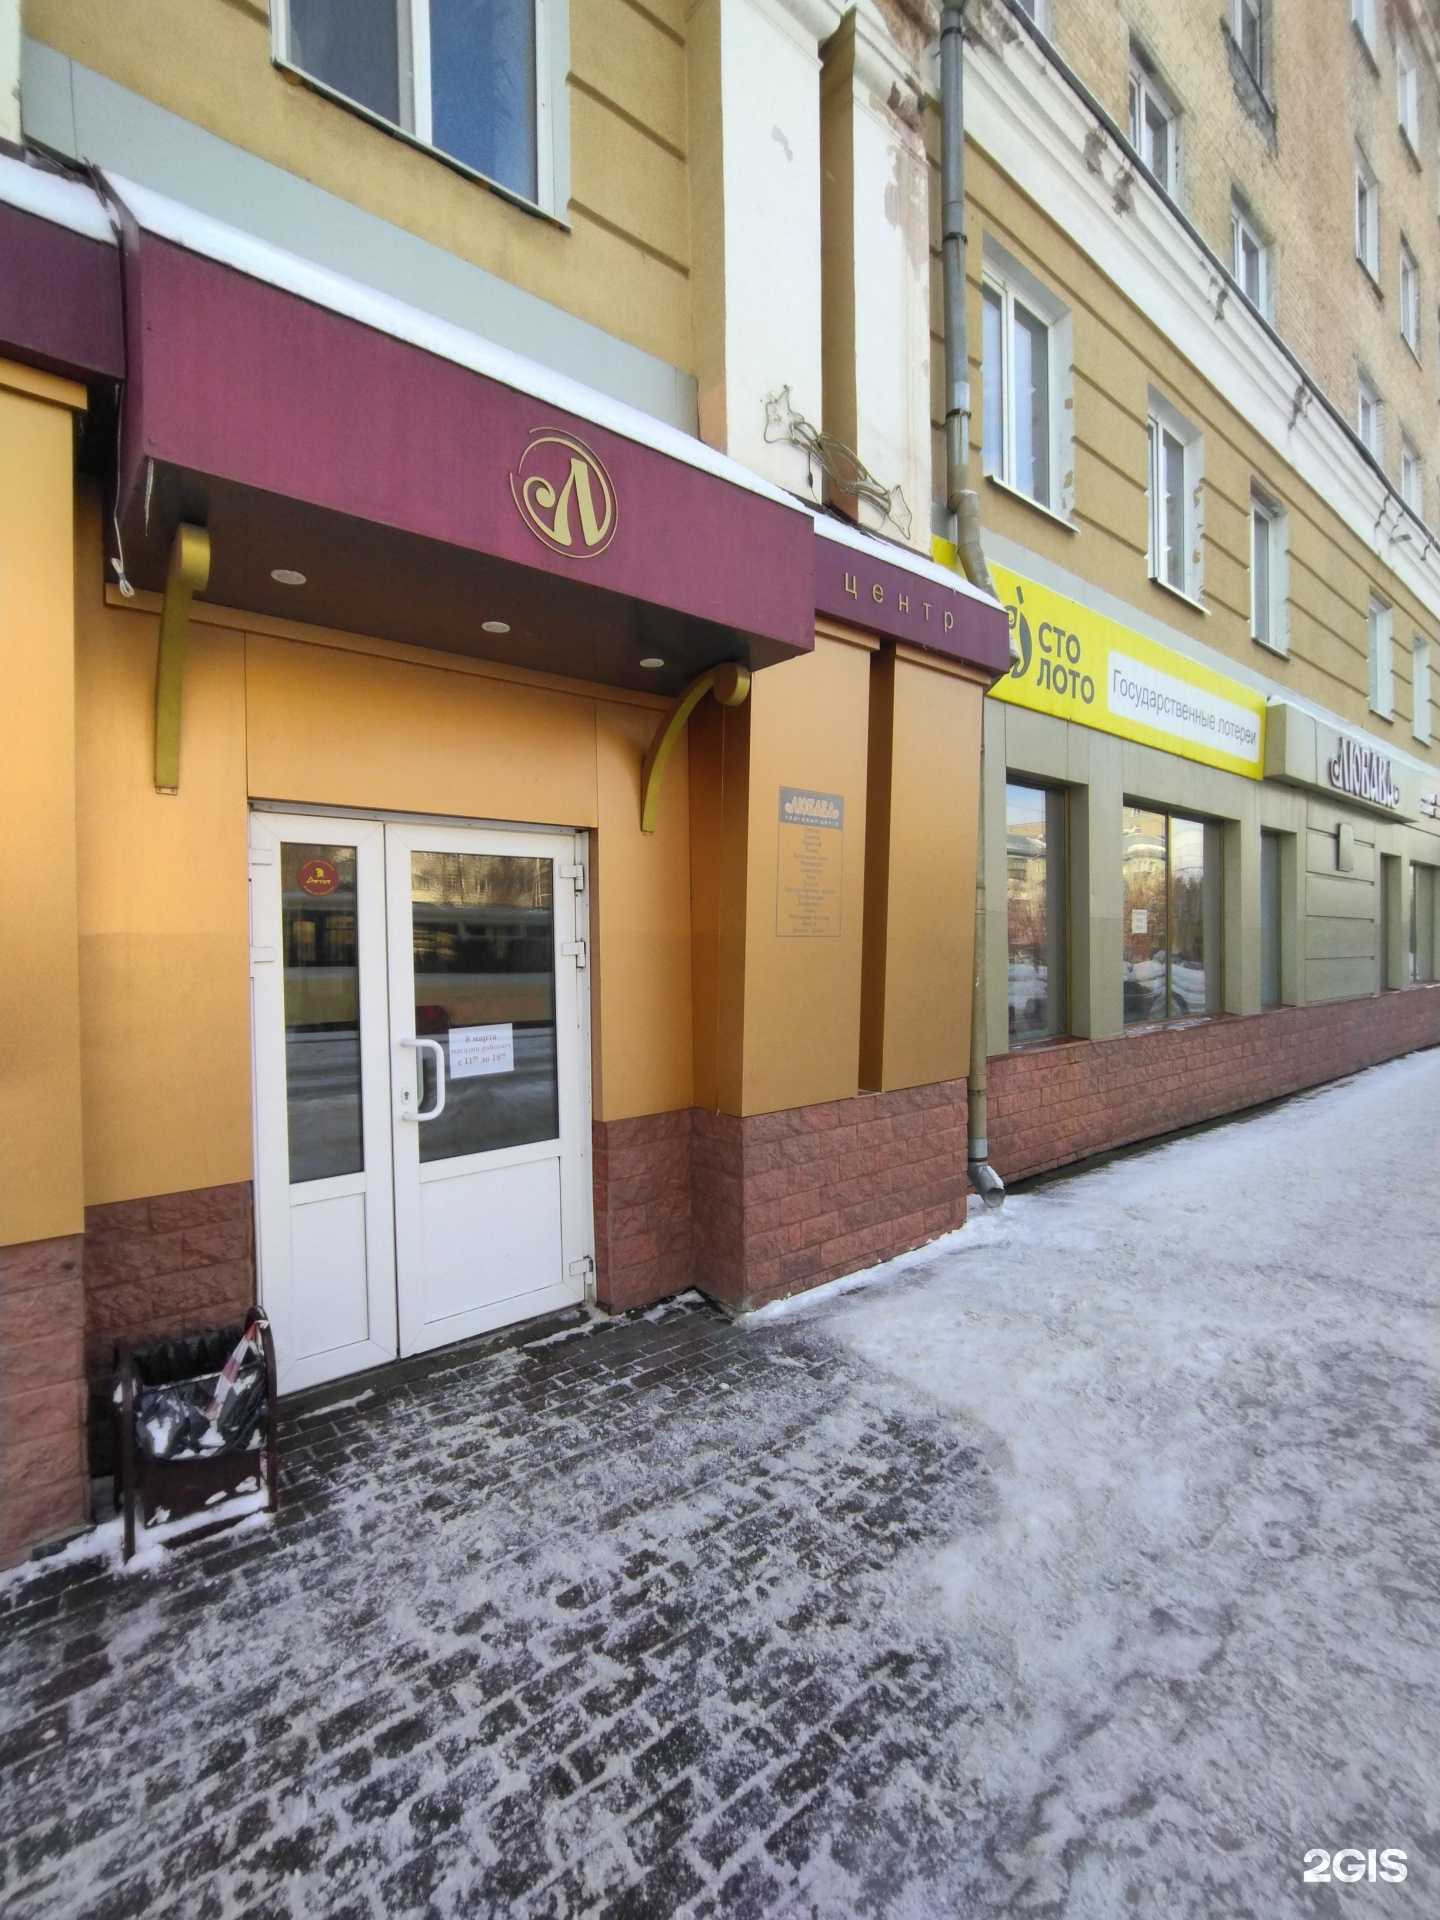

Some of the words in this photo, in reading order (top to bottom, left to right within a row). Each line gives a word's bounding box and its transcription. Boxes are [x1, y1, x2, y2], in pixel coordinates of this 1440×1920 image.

[844, 572, 954, 633] центр
[1038, 622, 1081, 664] СТО
[1036, 658, 1095, 704] ЛОТО
[1112, 669, 1216, 731] Государственные
[1217, 718, 1257, 746] лотереи
